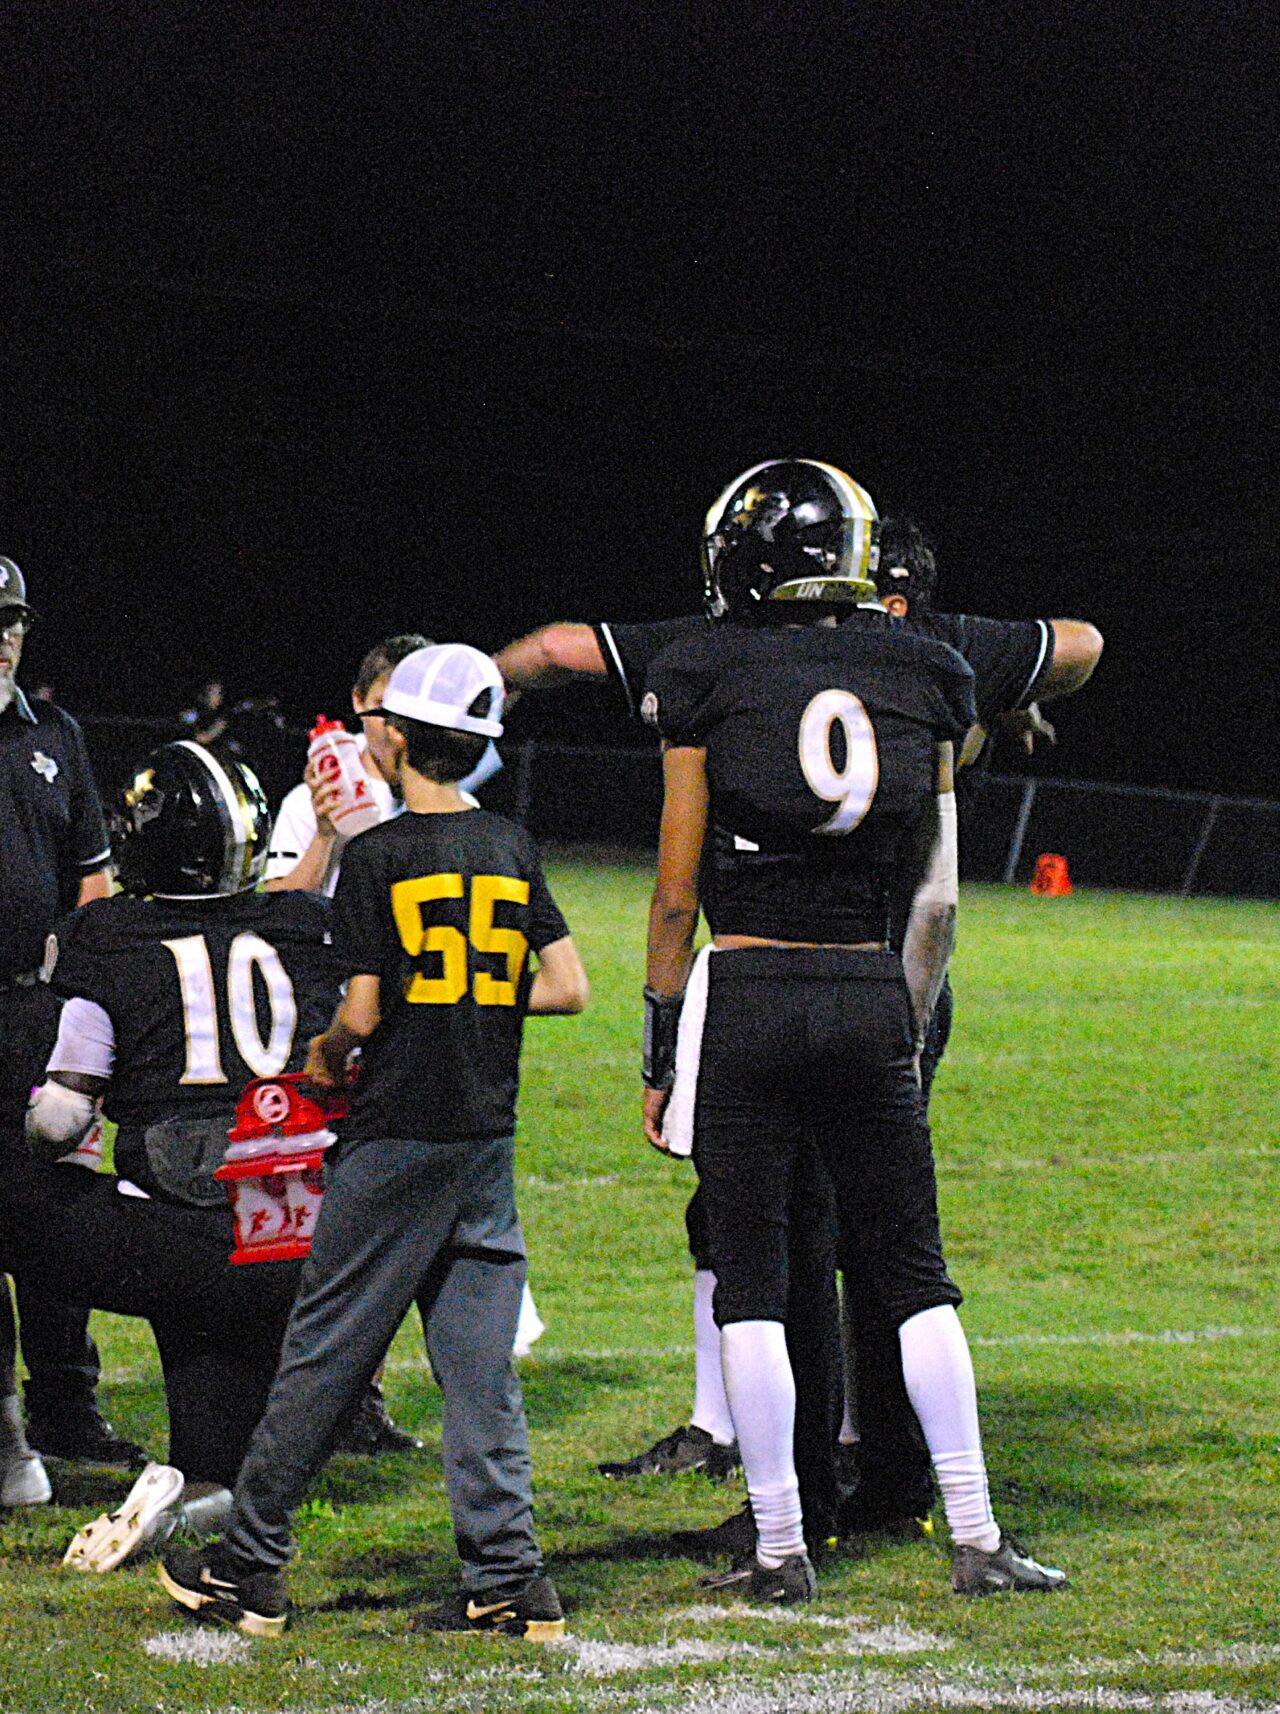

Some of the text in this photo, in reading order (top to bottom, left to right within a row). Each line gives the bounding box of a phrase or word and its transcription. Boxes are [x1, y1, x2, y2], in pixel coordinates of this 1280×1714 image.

[798, 688, 879, 836] 9
[160, 930, 298, 1085] 10
[391, 873, 530, 1006] 55
